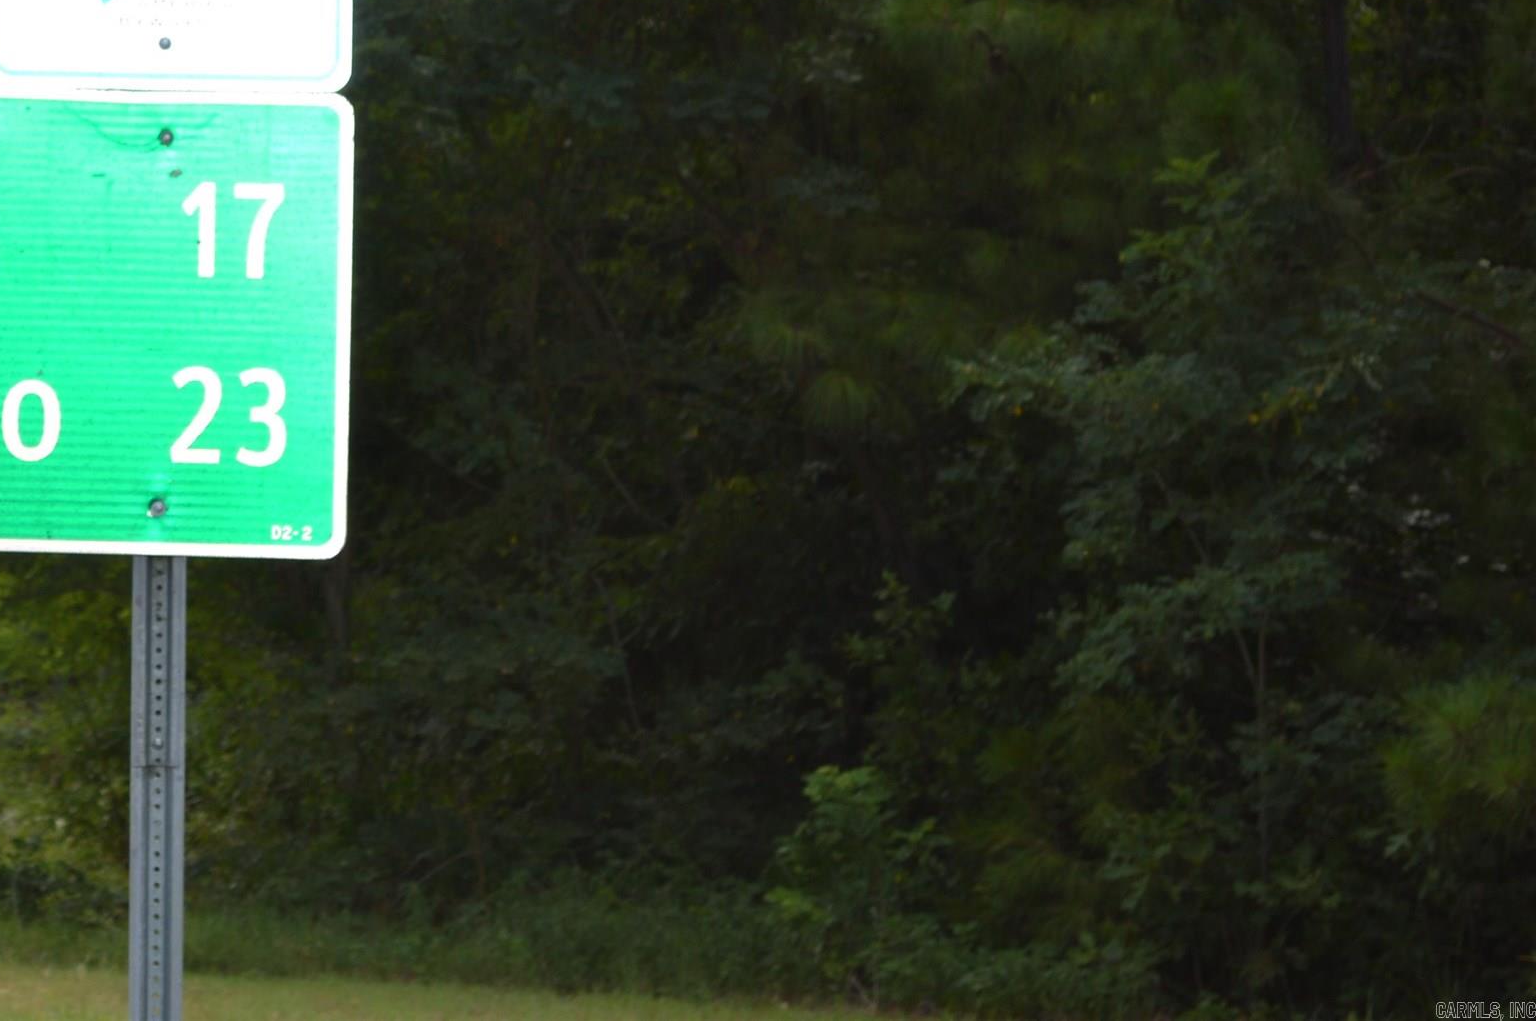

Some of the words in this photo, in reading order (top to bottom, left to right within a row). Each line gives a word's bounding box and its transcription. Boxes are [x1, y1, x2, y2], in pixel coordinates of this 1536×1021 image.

[181, 181, 286, 280] 17
[169, 365, 289, 468] 23
[271, 525, 313, 541] D2-2
